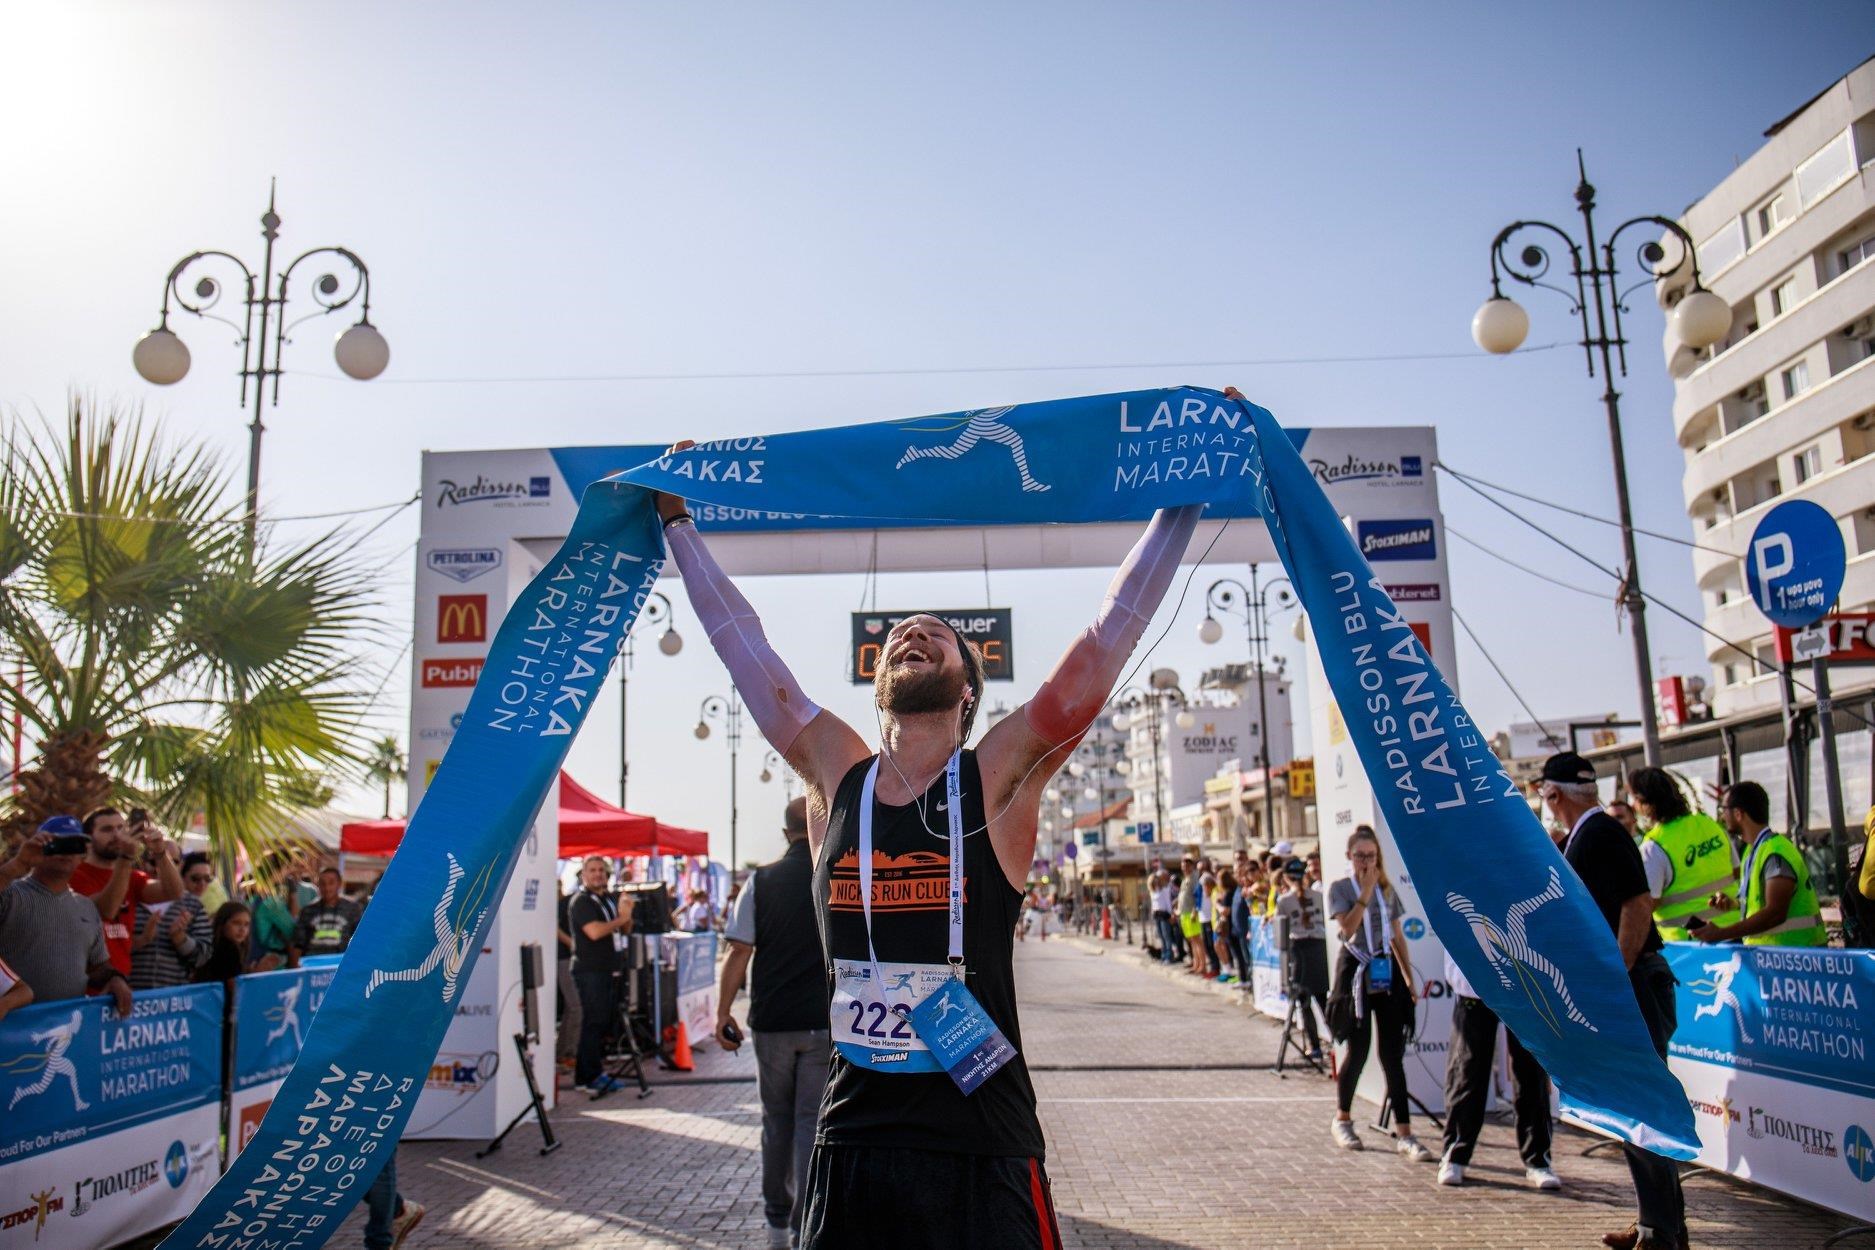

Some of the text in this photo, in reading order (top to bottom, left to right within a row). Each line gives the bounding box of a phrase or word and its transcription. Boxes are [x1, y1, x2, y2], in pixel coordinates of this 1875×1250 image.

[1309, 455, 1399, 484] Radisson
[438, 475, 528, 508] Radisson
[433, 552, 495, 564] PETROLINA
[1754, 532, 1792, 611] P
[488, 542, 595, 731] MARATHON
[518, 543, 610, 733] INTERNATIONAL
[540, 551, 642, 737] LARNAKA
[1331, 571, 1425, 815] RADISSON BLU
[1368, 576, 1467, 811] LARNAKA
[1184, 736, 1238, 748] ZODIAC
[836, 883, 878, 901] NICKS
[882, 883, 911, 901] RUN
[1756, 952, 1853, 975] RADISSON BLU
[171, 995, 193, 1011] BLU
[1759, 975, 1858, 1010] LARNAKA
[941, 1017, 979, 1049] LARNAKA
[1761, 1006, 1860, 1031] INTERNATIONAL
[101, 1017, 191, 1055] LARNAKA
[882, 1040, 911, 1048] Hampson
[949, 1025, 987, 1058] MARATHON
[1763, 1023, 1864, 1061] MARATHON
[101, 1049, 191, 1074] INTERNATIONAL
[1726, 1051, 1753, 1067] Partners
[102, 1063, 190, 1102] MARATHON
[20, 1138, 34, 1151] For
[36, 1133, 52, 1147] Our
[53, 1125, 87, 1143] Partners
[323, 1077, 414, 1206] RADISSON
[1764, 1114, 1835, 1151] ΠΟΛΙΤΗΣ
[92, 1160, 160, 1201] ΠΟΛΙΤΗΣ
[46, 1196, 63, 1214] FM
